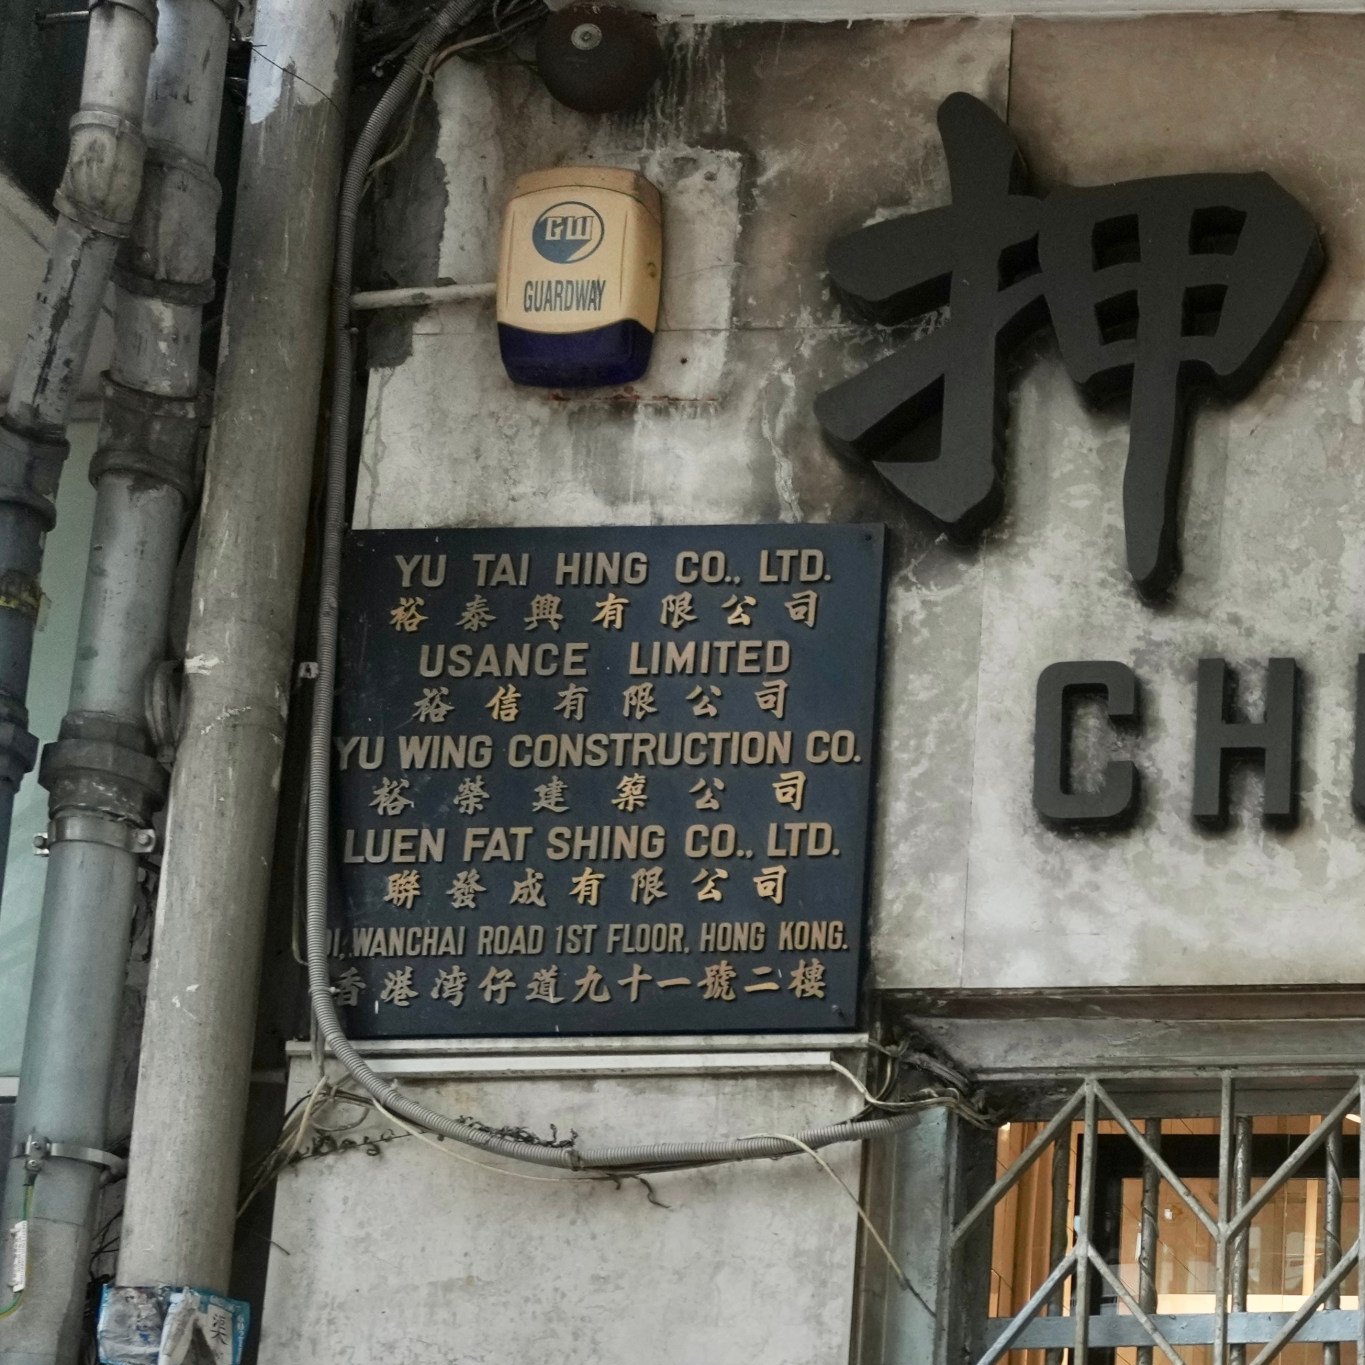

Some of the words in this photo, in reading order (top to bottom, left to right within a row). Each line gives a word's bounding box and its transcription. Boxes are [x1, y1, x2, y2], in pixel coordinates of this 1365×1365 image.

[545, 215, 595, 241] GW
[523, 279, 607, 313] GUARDWAY
[396, 554, 447, 588] YU
[473, 552, 530, 588] TAI
[555, 550, 649, 587] HING
[758, 548, 833, 583] LTD.
[390, 590, 819, 634] 裕泰興有限公司
[419, 642, 590, 678] USANCE
[628, 639, 792, 675] LIMITED
[412, 679, 789, 724] 裕信有限公司
[335, 735, 385, 771] YU
[399, 734, 493, 769] WING
[507, 730, 792, 768] CONSTRUCTION
[804, 729, 863, 764] CO.
[343, 826, 445, 864] LUEN
[462, 825, 533, 862] FAT
[546, 824, 666, 861] SHING
[766, 821, 841, 857] LTD.
[384, 864, 789, 910] 聯發成有限公司
[352, 925, 466, 958] WANCHAI
[477, 924, 545, 956] ROAD
[554, 923, 598, 955] 1ST
[700, 921, 766, 952] HONG
[778, 920, 849, 951] KONG.
